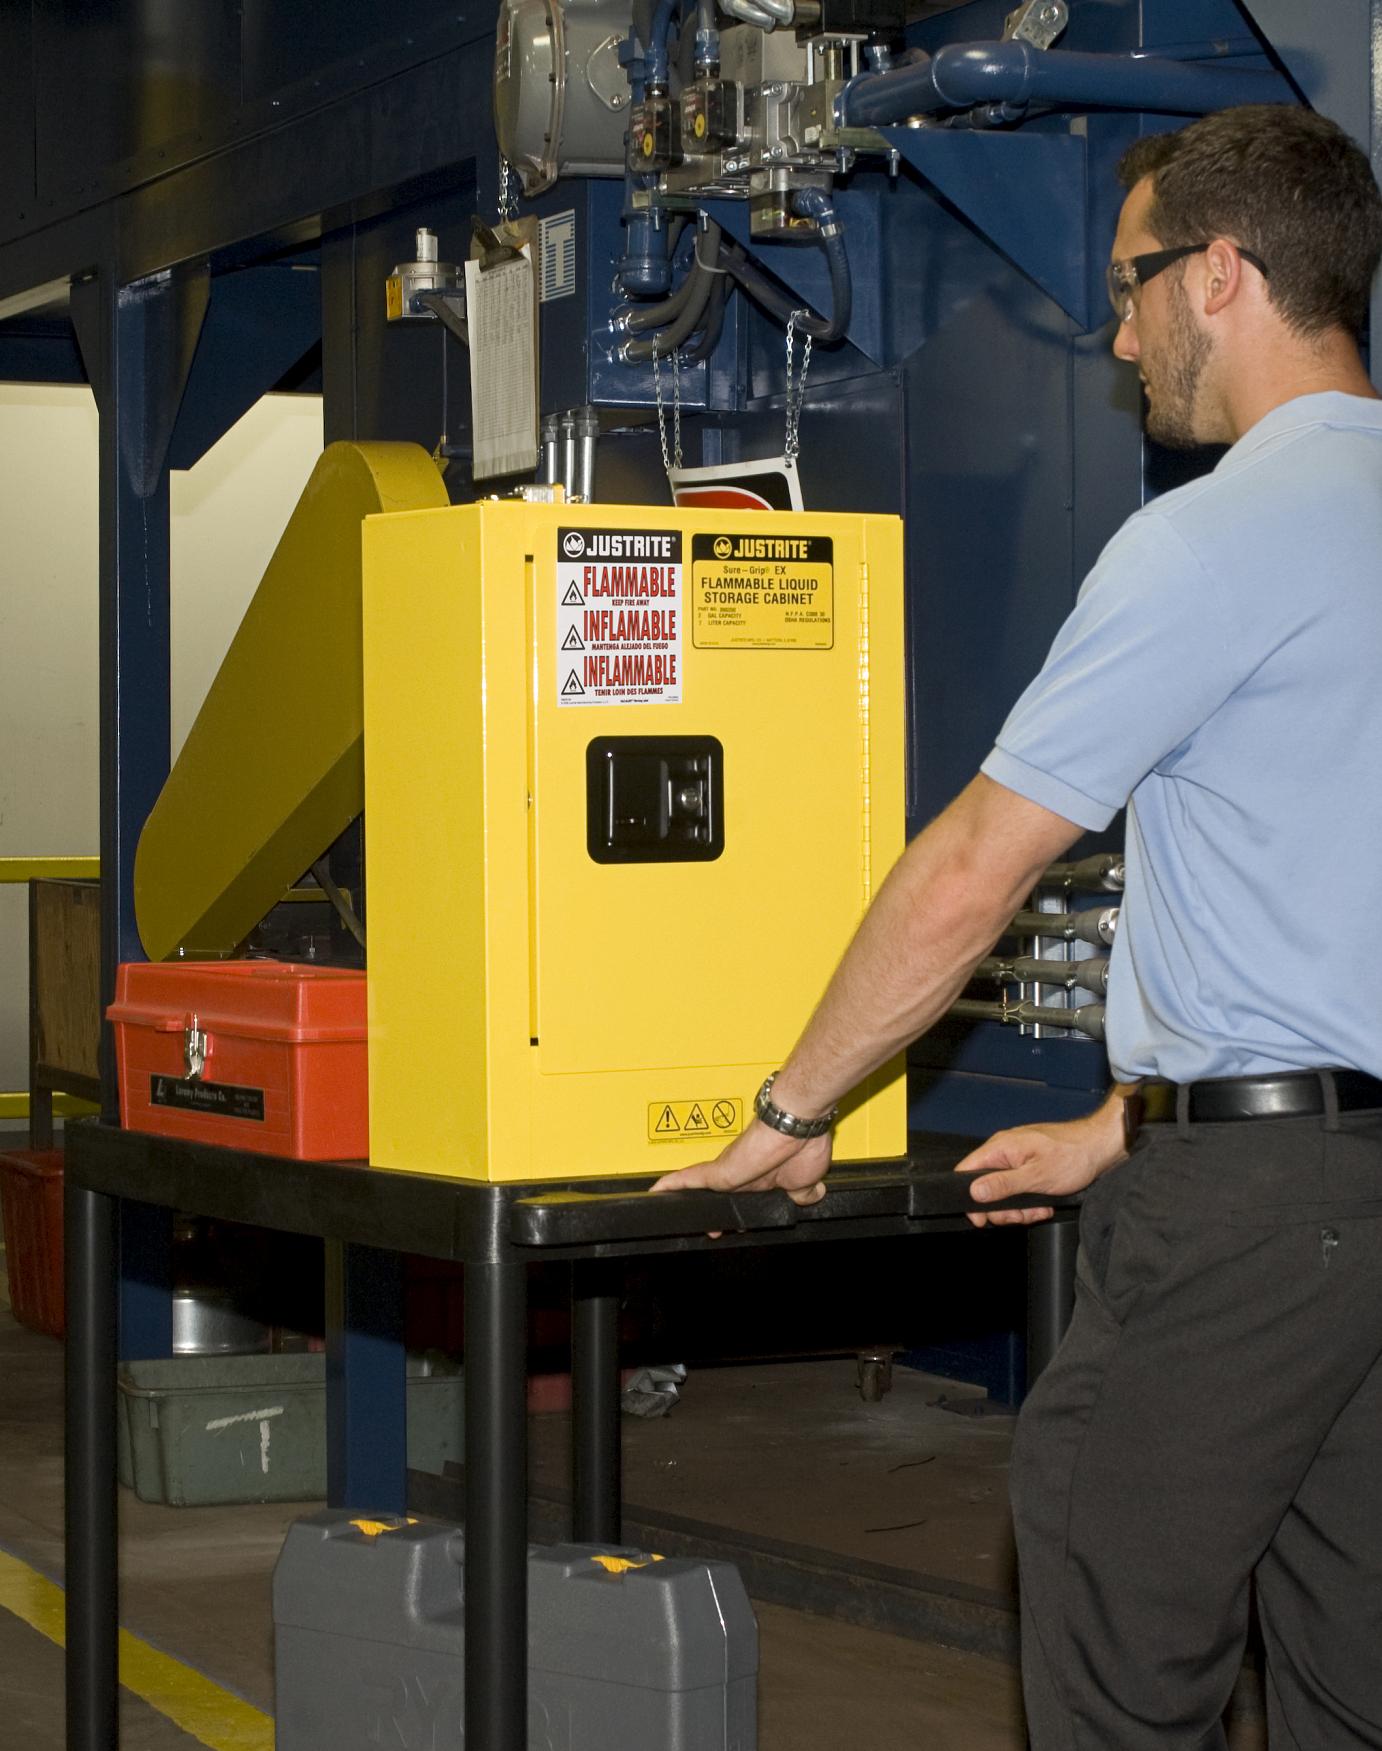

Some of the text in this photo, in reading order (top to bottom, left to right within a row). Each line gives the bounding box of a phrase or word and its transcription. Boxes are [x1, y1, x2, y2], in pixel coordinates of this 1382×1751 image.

[586, 535, 671, 557] JUSTRITE
[734, 538, 808, 558] JUSTRITE
[774, 566, 786, 575] EX
[583, 566, 676, 597] FLAMMABLE
[701, 577, 818, 590] FLAMMABLE LIQUID
[704, 592, 814, 604] STORAGE CABINET
[583, 610, 677, 641] INFLAMABLE
[583, 655, 677, 687] INFLAMMABLE
[638, 687, 663, 695] FLAMMES
